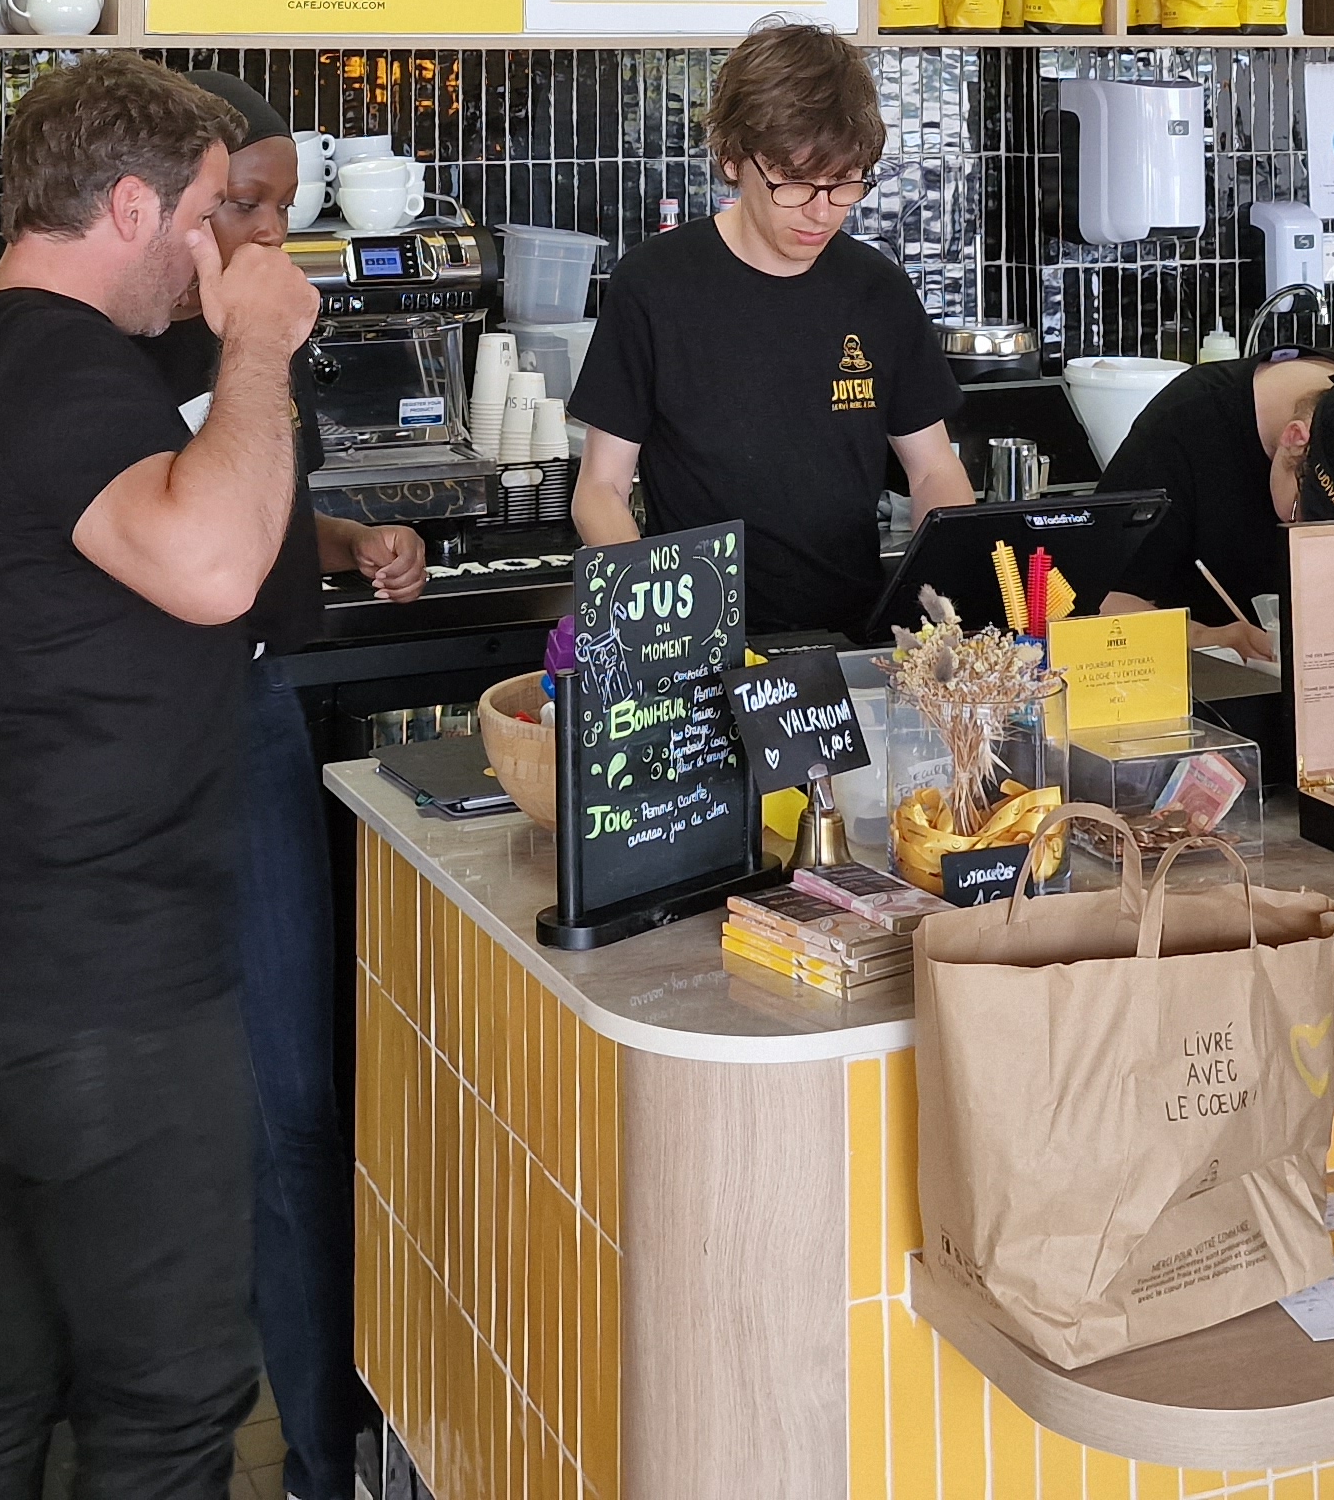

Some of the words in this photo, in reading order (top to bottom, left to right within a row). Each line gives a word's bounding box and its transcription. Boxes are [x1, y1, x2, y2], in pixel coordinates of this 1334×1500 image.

[288, 1, 385, 10] CAFEJOYEUX.COM
[832, 376, 875, 401] JOYEUX
[651, 544, 679, 574] NOS
[627, 574, 694, 620] JUS
[655, 622, 670, 636] DU
[641, 636, 692, 662] MOMENT
[734, 677, 799, 714] Tablette
[778, 698, 853, 739] VALRHONA
[1187, 1059, 1237, 1086] AVEC
[1165, 1095, 1189, 1121] LE
